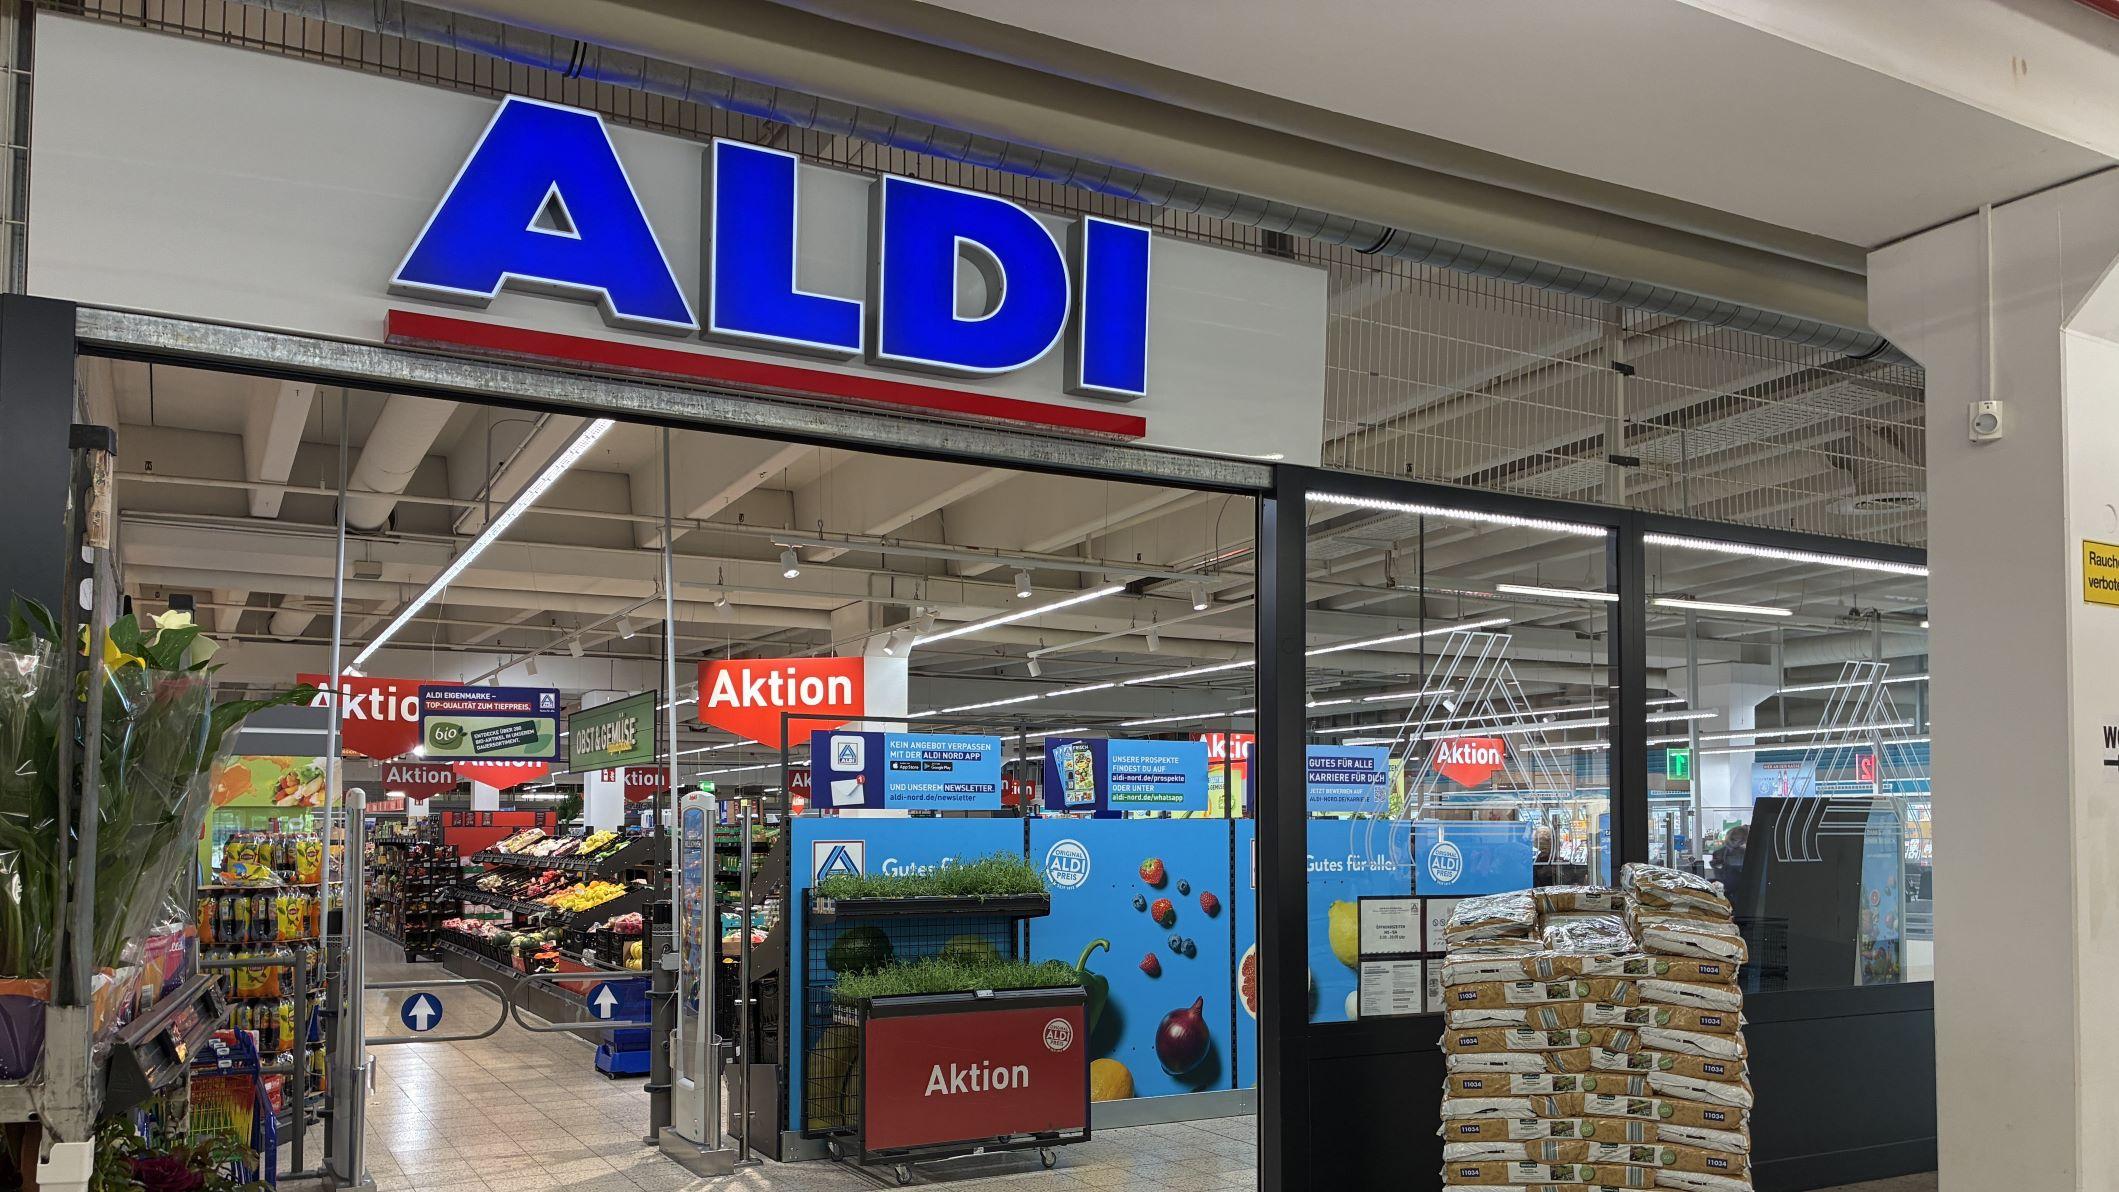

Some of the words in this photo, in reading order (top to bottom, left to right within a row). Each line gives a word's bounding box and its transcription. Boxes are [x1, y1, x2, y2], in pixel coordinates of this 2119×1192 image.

[389, 94, 1151, 397] ALDI
[2089, 551, 2119, 568] Rauch
[707, 667, 852, 708] Aktion
[444, 692, 491, 700] EIGENMARKE
[426, 701, 477, 709] TOP-QUALITÄT
[477, 702, 493, 710] ZUM
[494, 703, 531, 711] TIEFPREIS.
[435, 727, 457, 741] bio
[2103, 725, 2119, 749] W
[890, 741, 909, 749] KEIN
[910, 741, 946, 750] ANGEBOT
[947, 742, 991, 751] VERPASSEN
[905, 751, 921, 759] DER
[942, 752, 964, 760] NORD
[965, 753, 981, 761] APP
[1437, 741, 1500, 765] Aktion
[1112, 755, 1140, 763] UNSERE
[1140, 756, 1180, 764] PROSPEKTE
[1309, 758, 1336, 768] GUTES
[1337, 757, 1354, 769] FÜR
[1354, 760, 1373, 769] ALLE
[386, 766, 452, 784] Aktion
[1112, 774, 1185, 783] aldi-nord.de/prospekte
[1309, 773, 1350, 782] KARRIERE
[1350, 771, 1366, 782] FÜR
[1367, 774, 1385, 783] DICH
[890, 783, 906, 791] UND
[907, 783, 944, 791] UNSEREM
[944, 784, 995, 792] NEWSLETTER.
[1112, 784, 1131, 792] ODER
[890, 793, 977, 802] aldi-nord.de/newsletter
[1112, 794, 1184, 802] aldi-nord.de/whatsapp
[1055, 850, 1083, 859] ORIGINAL
[882, 857, 936, 878] Gutes
[1050, 857, 1086, 874] ALDI
[1306, 854, 1343, 872] Gutes
[1346, 854, 1367, 872] für
[1370, 854, 1397, 871] alle.
[1431, 856, 1459, 871] ALDI
[1056, 872, 1077, 881] PREIS
[1436, 870, 1453, 878] PREIS
[1700, 966, 1719, 974] 11034
[1701, 1017, 1721, 1025] 11034
[1046, 1030, 1070, 1042] ALDI
[1704, 1065, 1724, 1073] 11034
[925, 1061, 1029, 1097] Aktion
[1705, 1112, 1724, 1120] 11034
[1707, 1159, 1727, 1168] 11034
